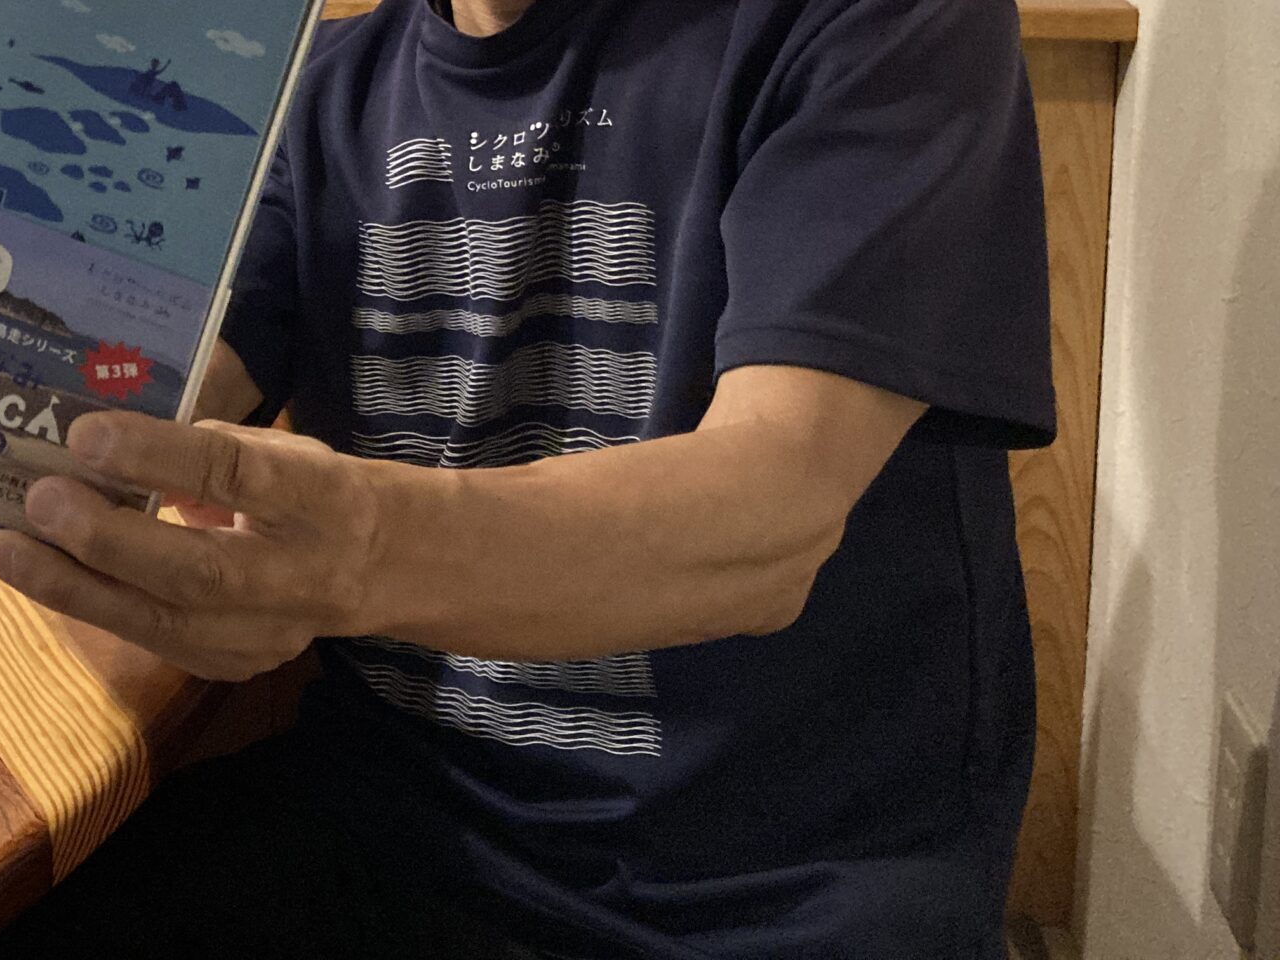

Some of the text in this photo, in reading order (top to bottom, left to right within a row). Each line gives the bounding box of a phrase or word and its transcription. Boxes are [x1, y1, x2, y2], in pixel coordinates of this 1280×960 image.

[469, 146, 550, 172] しまなみ
[95, 362, 138, 380] 第3弾
